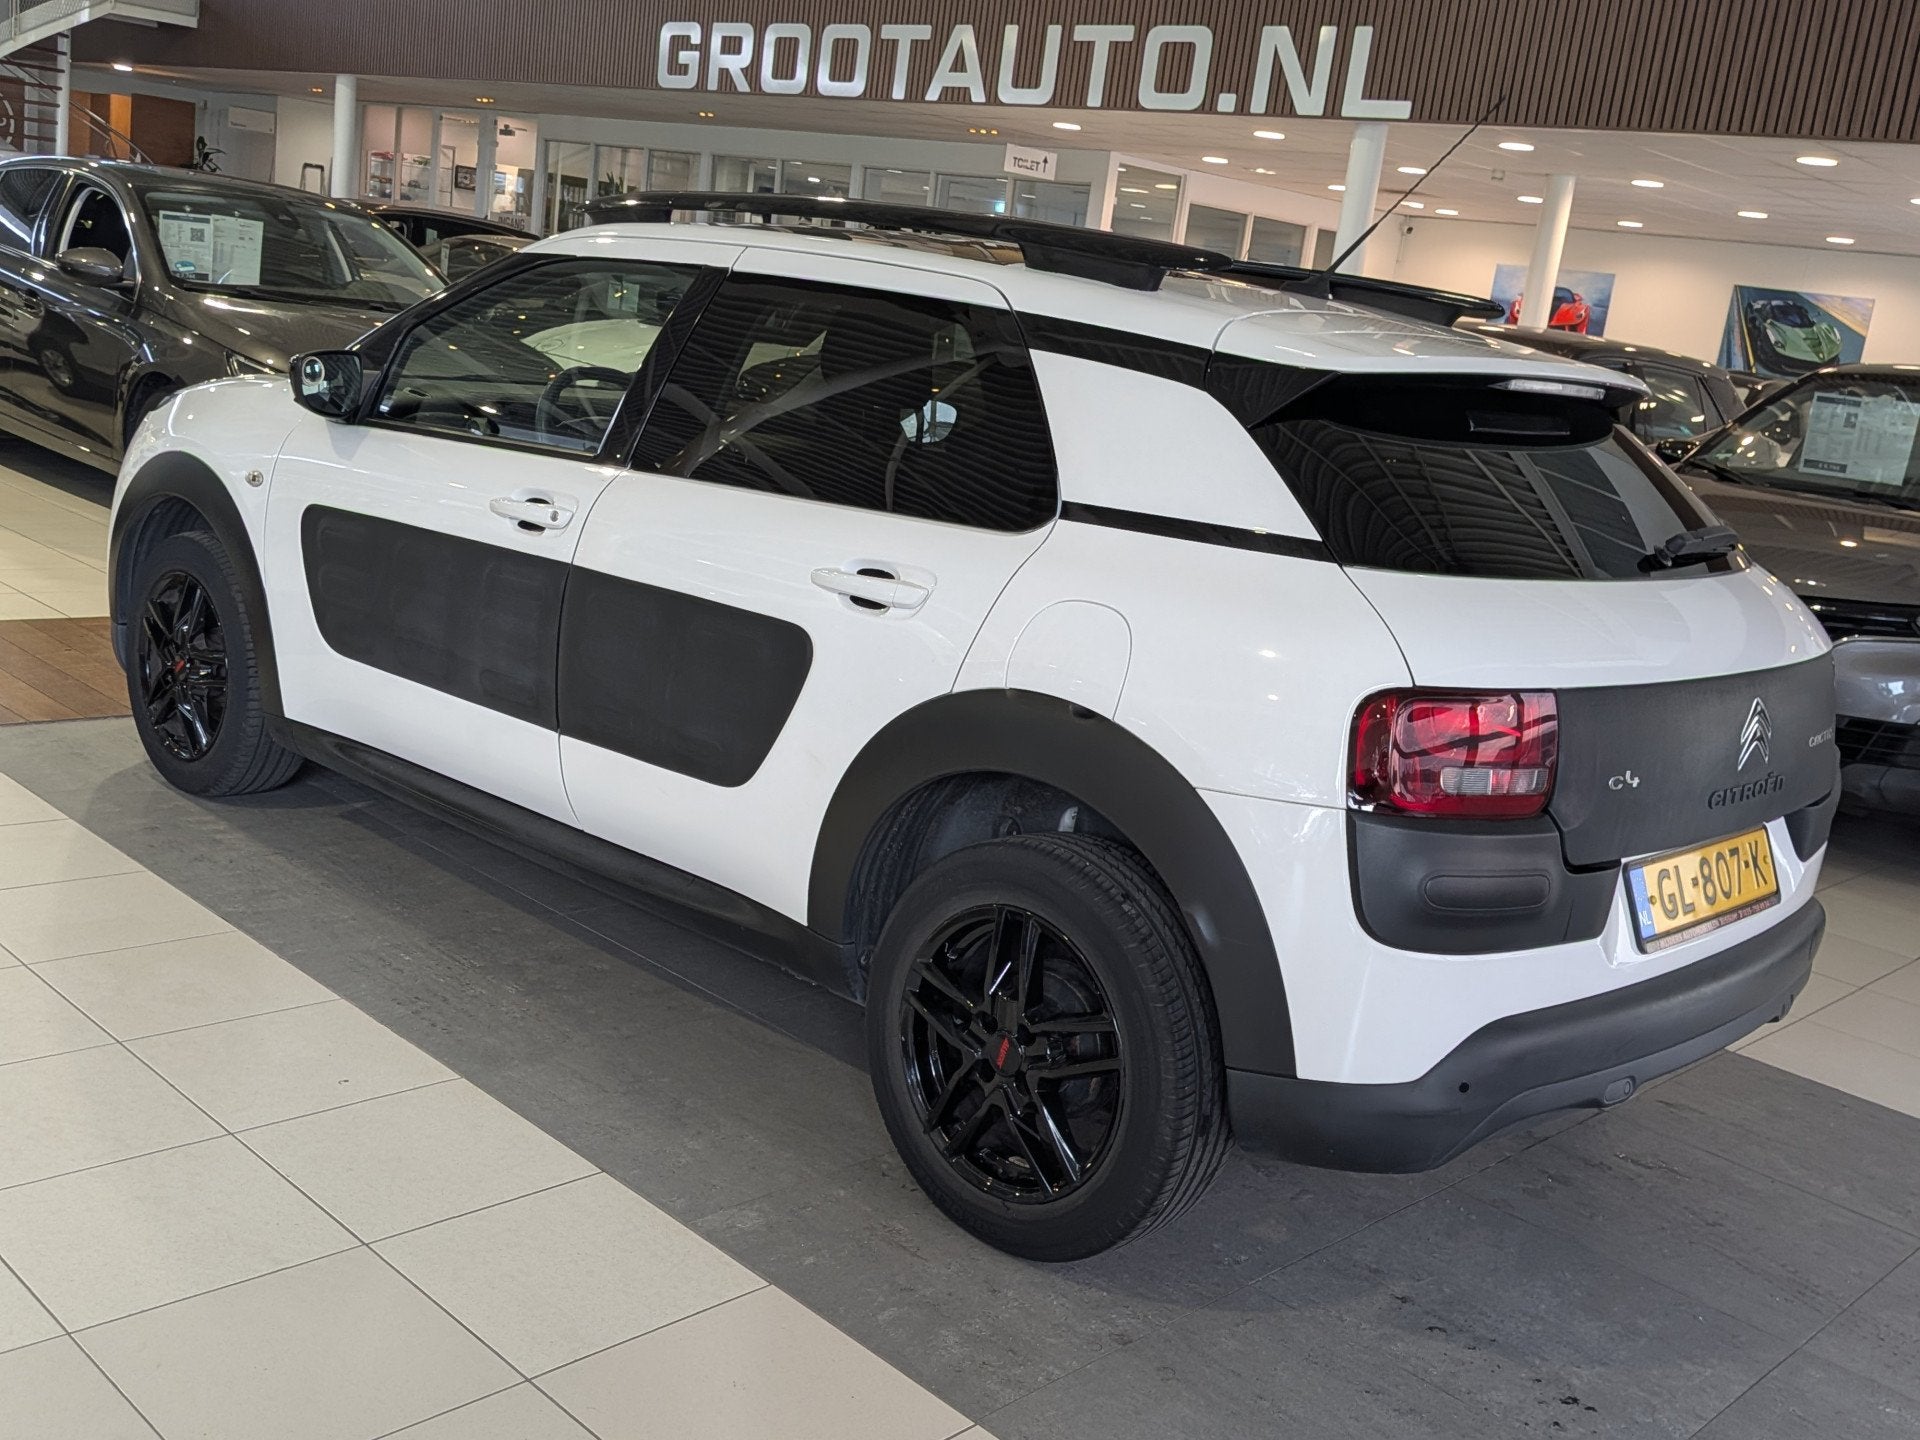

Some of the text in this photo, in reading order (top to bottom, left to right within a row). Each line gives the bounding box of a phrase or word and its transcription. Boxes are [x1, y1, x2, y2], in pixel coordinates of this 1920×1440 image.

[658, 21, 1412, 119] GROOTAUTO.NL
[1013, 156, 1040, 171] TOILET
[1608, 770, 1640, 790] C4
[1657, 840, 1768, 920] GL-807-K
[1639, 911, 1652, 927] NL
